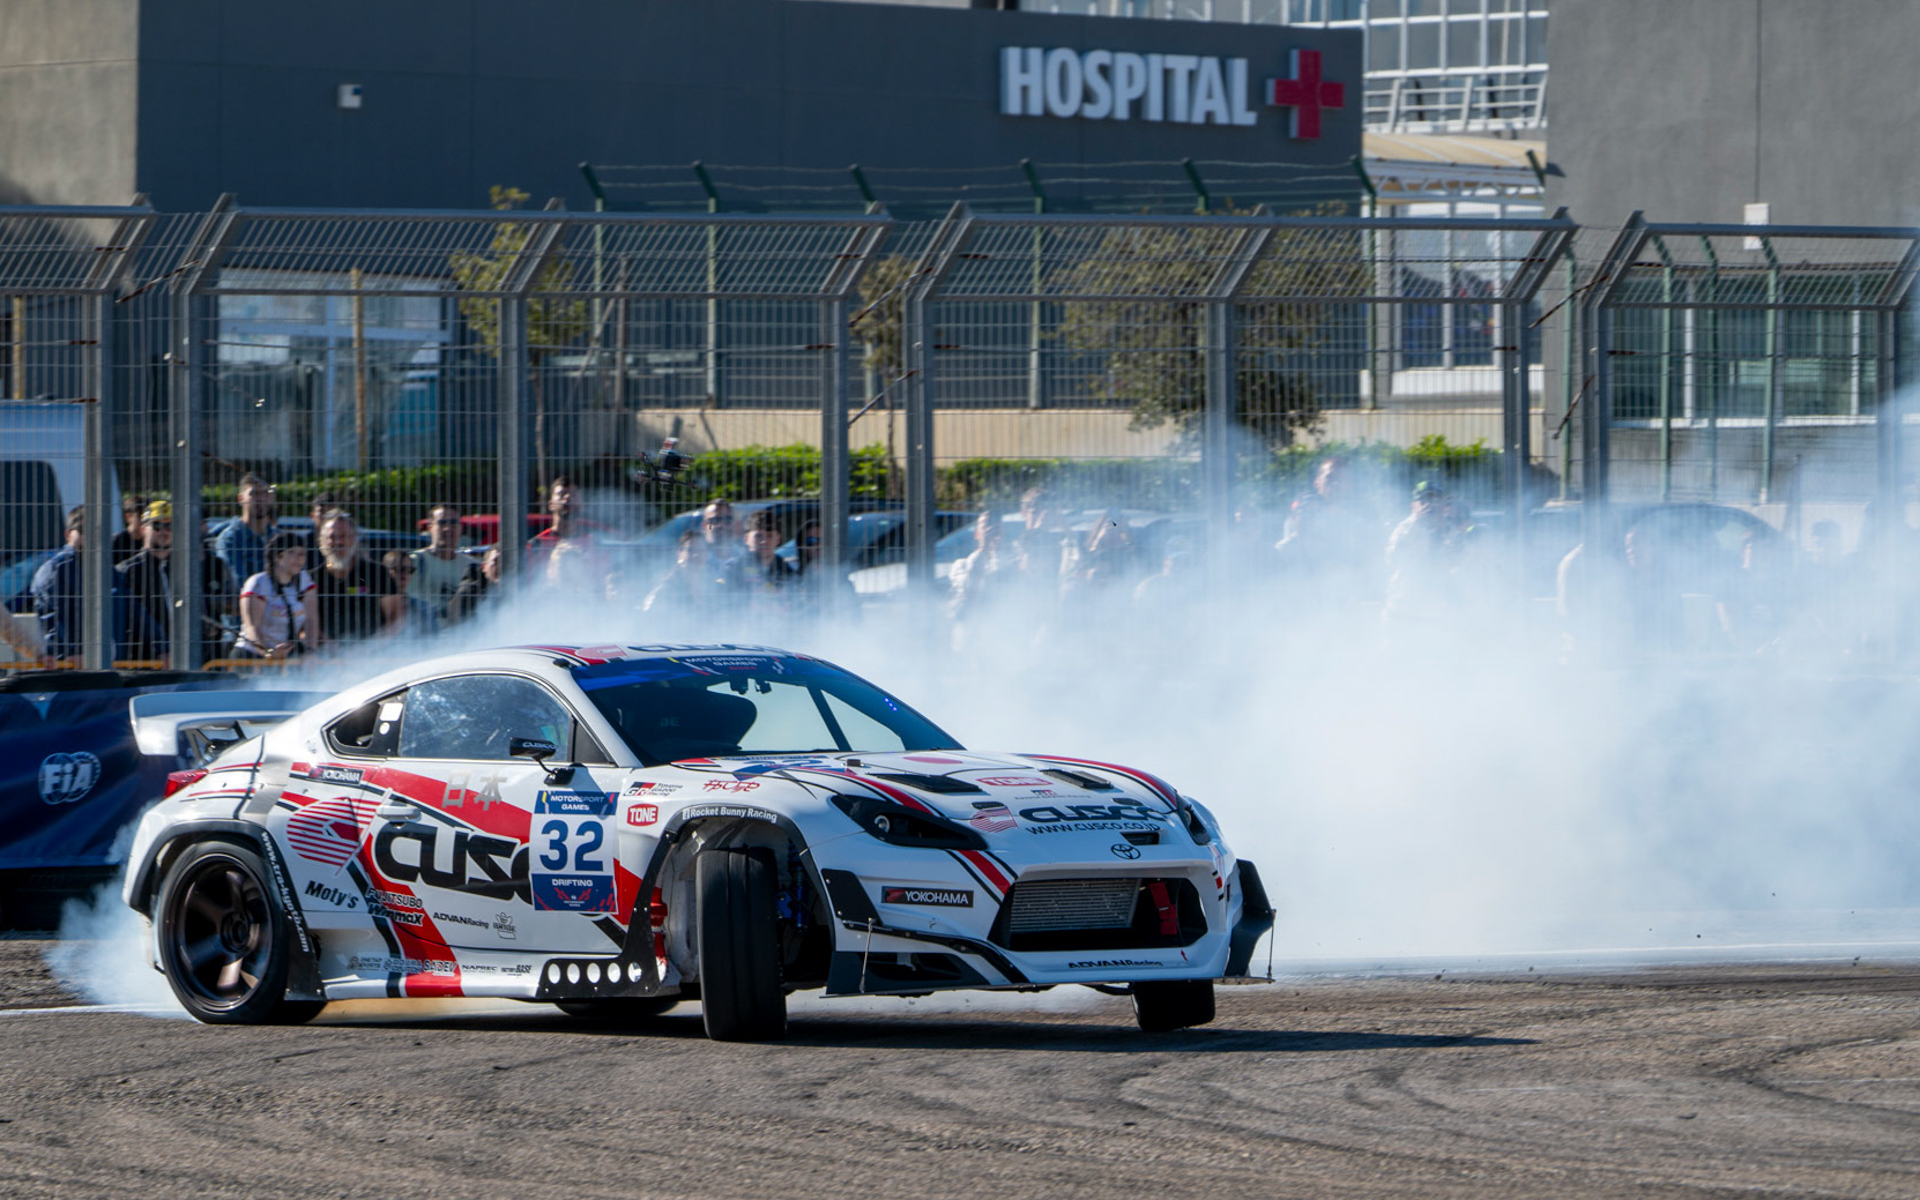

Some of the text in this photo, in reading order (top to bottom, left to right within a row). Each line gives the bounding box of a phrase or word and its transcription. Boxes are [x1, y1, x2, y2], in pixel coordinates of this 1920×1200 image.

[1001, 46, 1258, 127] HOSPITAL
[442, 769, 507, 812] 日本
[550, 795, 605, 803] MOTORSPORT
[561, 803, 590, 811] GAMES
[630, 807, 657, 823] TONE
[690, 806, 778, 824] Rocket Bunny Racing
[1019, 805, 1168, 823] CUSCO
[1025, 821, 1161, 836] www.cusco.co.jp
[539, 819, 604, 872] 32
[551, 878, 595, 888] DRIFTING
[304, 880, 359, 909] Moty's
[368, 888, 423, 909] FUJITSUBO
[904, 891, 969, 905] YOKOHAMA
